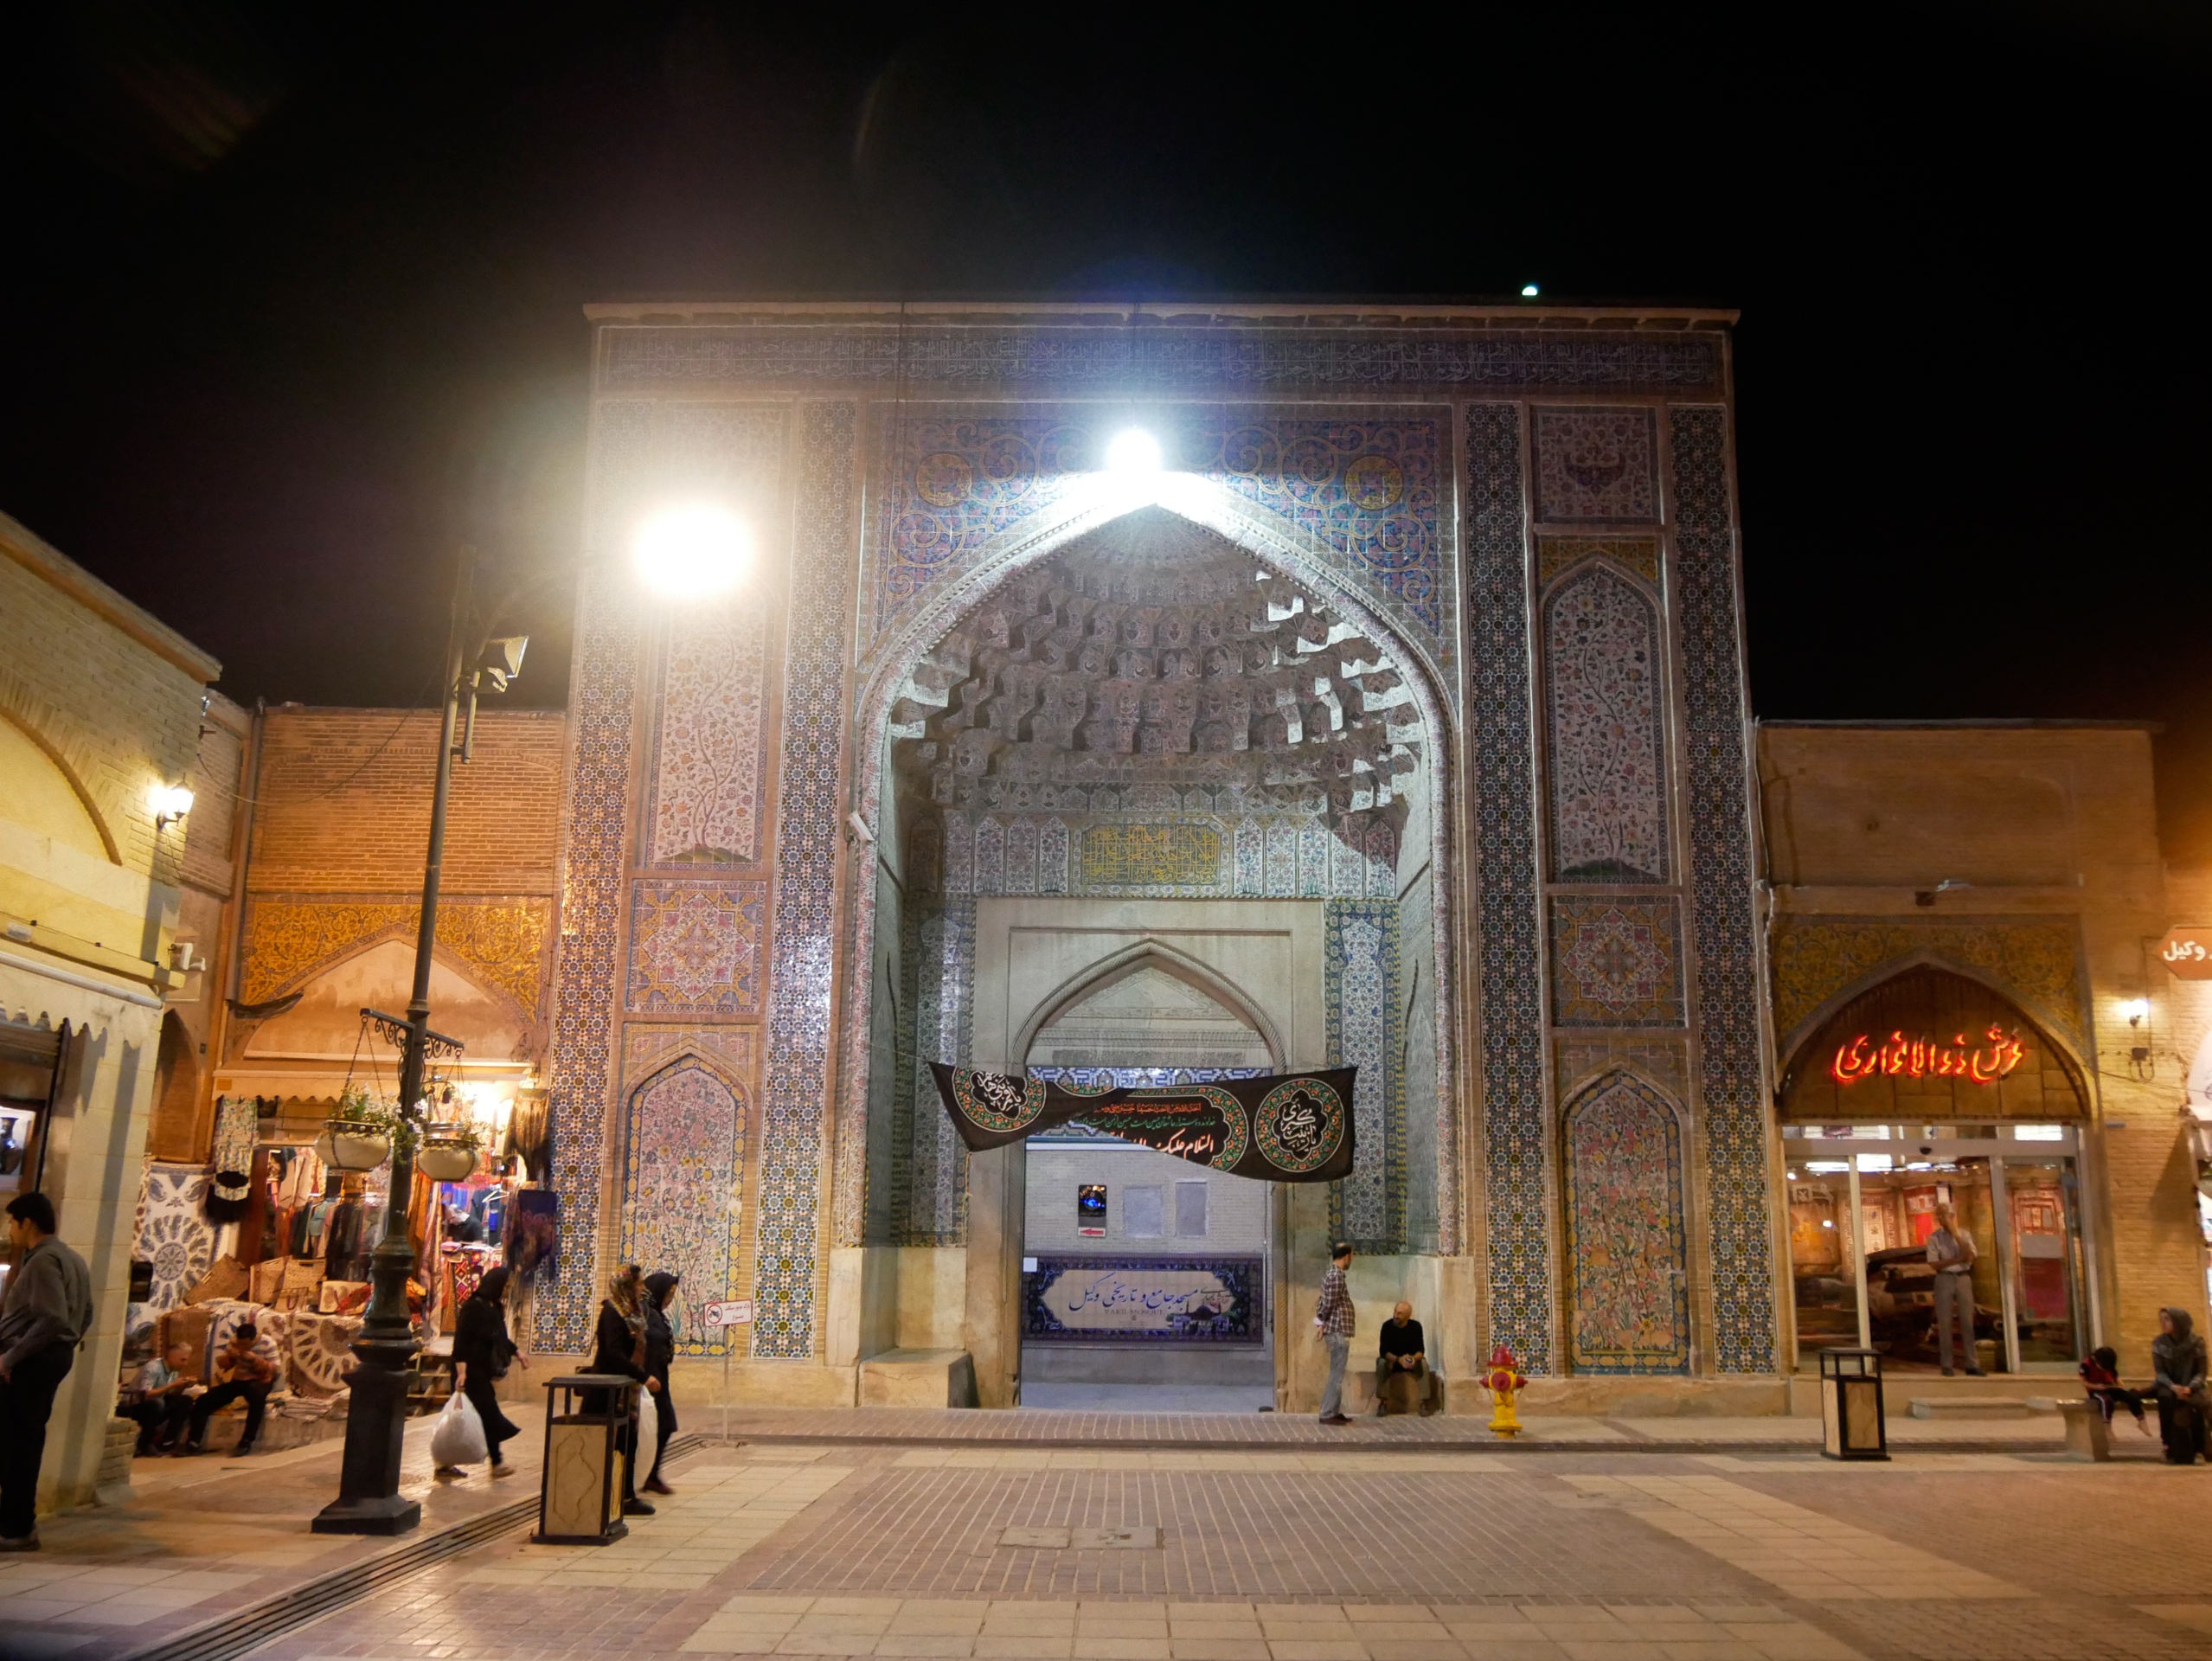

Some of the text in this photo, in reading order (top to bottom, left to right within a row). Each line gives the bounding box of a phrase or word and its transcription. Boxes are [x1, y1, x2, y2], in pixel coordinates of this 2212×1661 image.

[2163, 940, 2206, 961] وکیل
[1972, 1023, 2023, 1081] فرش
[1068, 1270, 1198, 1311] مسجد جامع و تاریخی وکیل
